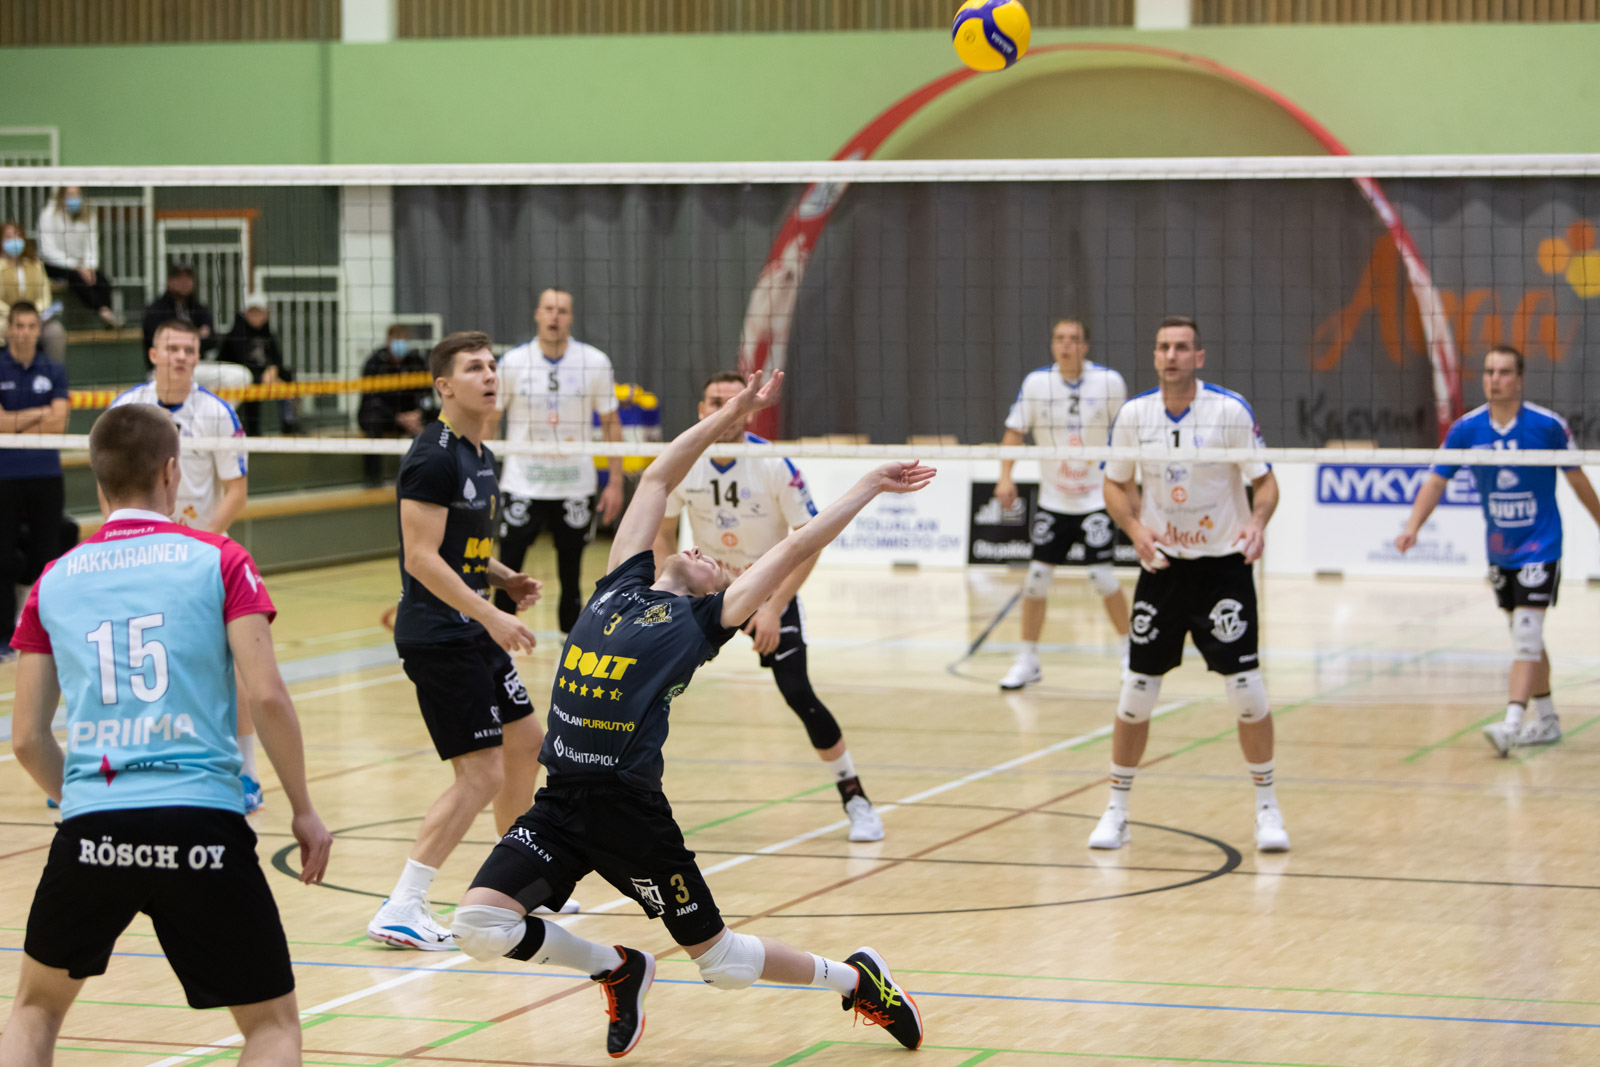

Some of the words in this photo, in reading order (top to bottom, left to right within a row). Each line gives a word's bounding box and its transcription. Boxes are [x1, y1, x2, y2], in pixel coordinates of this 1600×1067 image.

[1067, 394, 1081, 415] 2
[1171, 429, 1181, 449] 1
[709, 478, 741, 508] 14
[104, 526, 155, 540] jakosport.fi
[66, 543, 188, 577] HAKKARAINEN
[603, 612, 623, 636] 3
[86, 612, 170, 706] 15
[563, 644, 638, 681] BOLT
[71, 713, 198, 750] PRIIMA
[565, 746, 619, 767] LÄHITAPIOL
[78, 835, 179, 869] RÖSCH
[188, 845, 226, 870] OY
[670, 873, 690, 904] 3
[676, 902, 699, 917] JAKO
